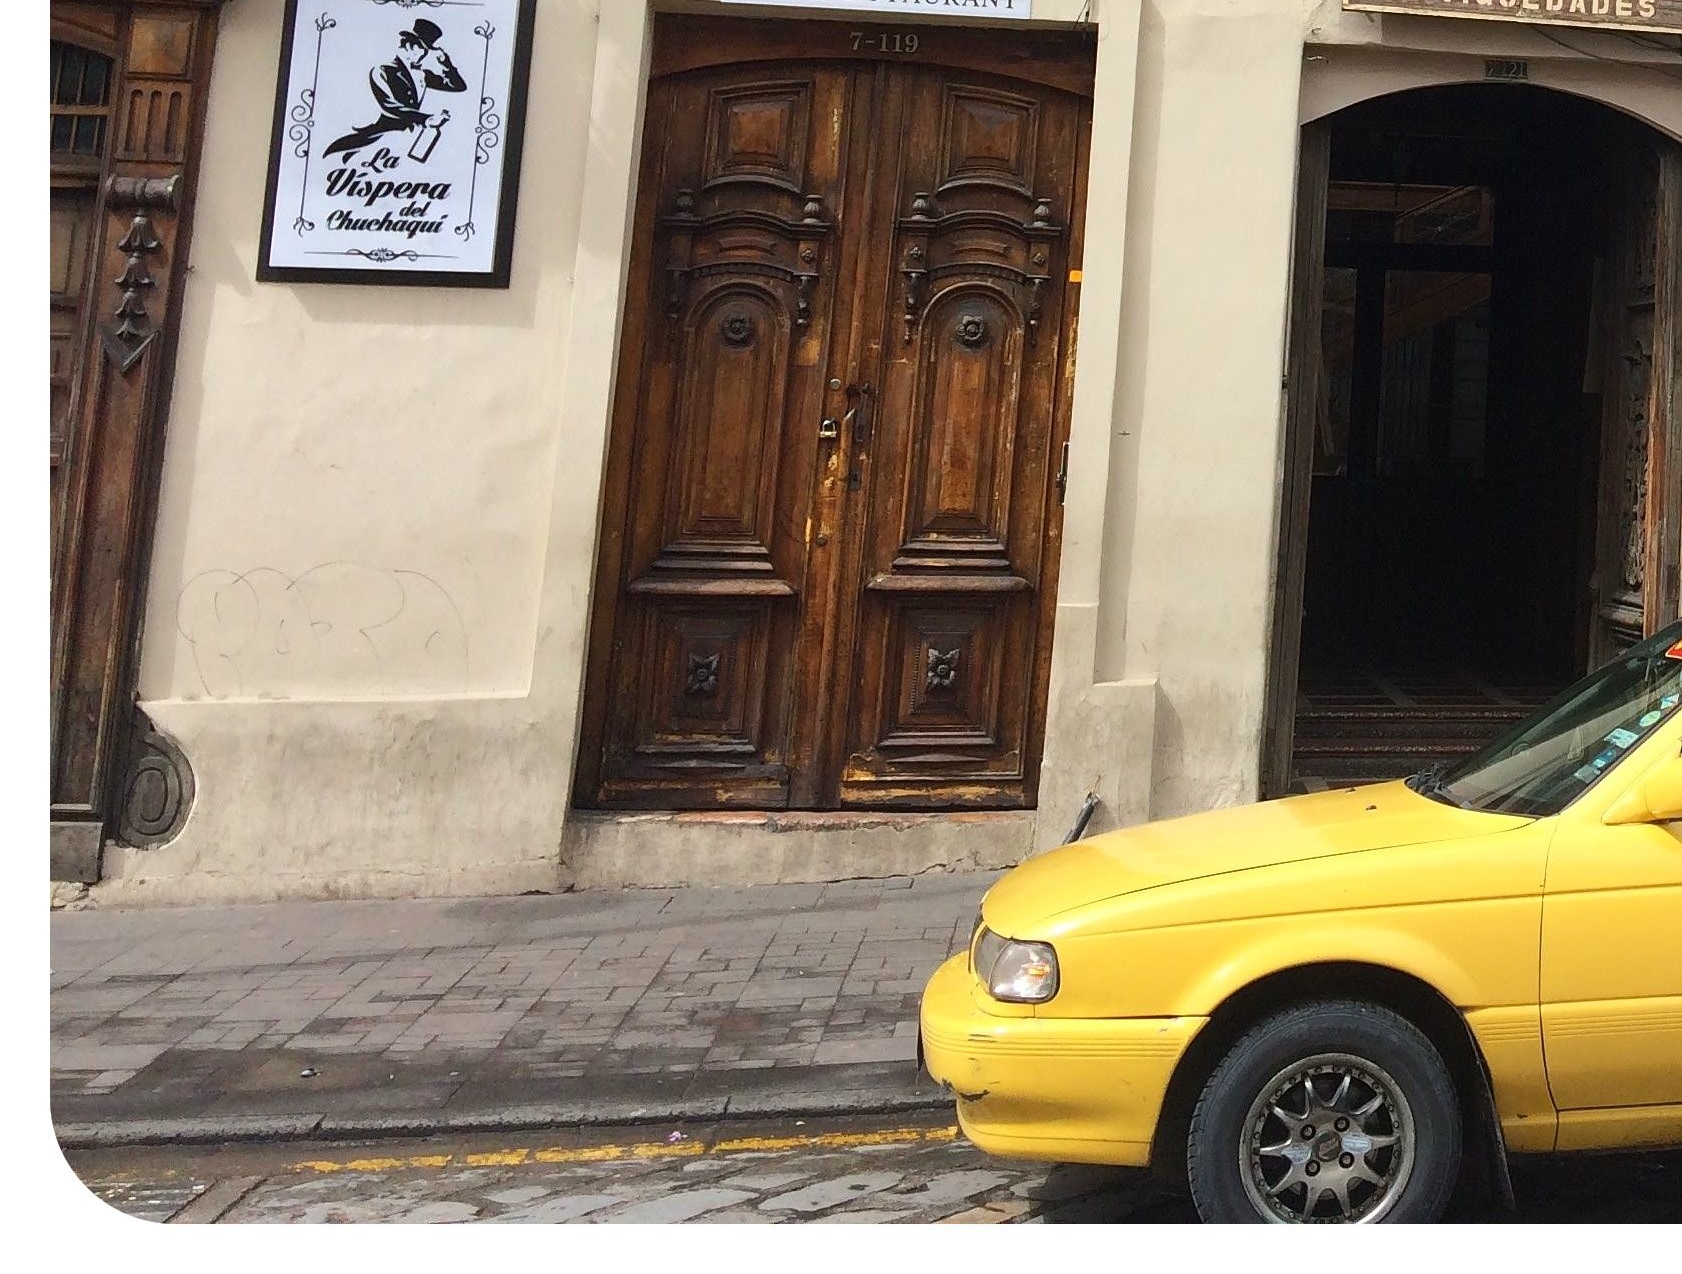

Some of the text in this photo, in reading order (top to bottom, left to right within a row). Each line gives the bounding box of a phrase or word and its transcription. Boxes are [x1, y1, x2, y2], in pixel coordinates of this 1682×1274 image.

[850, 32, 919, 54] 7-119
[361, 148, 399, 172] La
[326, 169, 452, 207] Víspera
[399, 201, 430, 217] del
[326, 210, 448, 239] Chuchaquí
